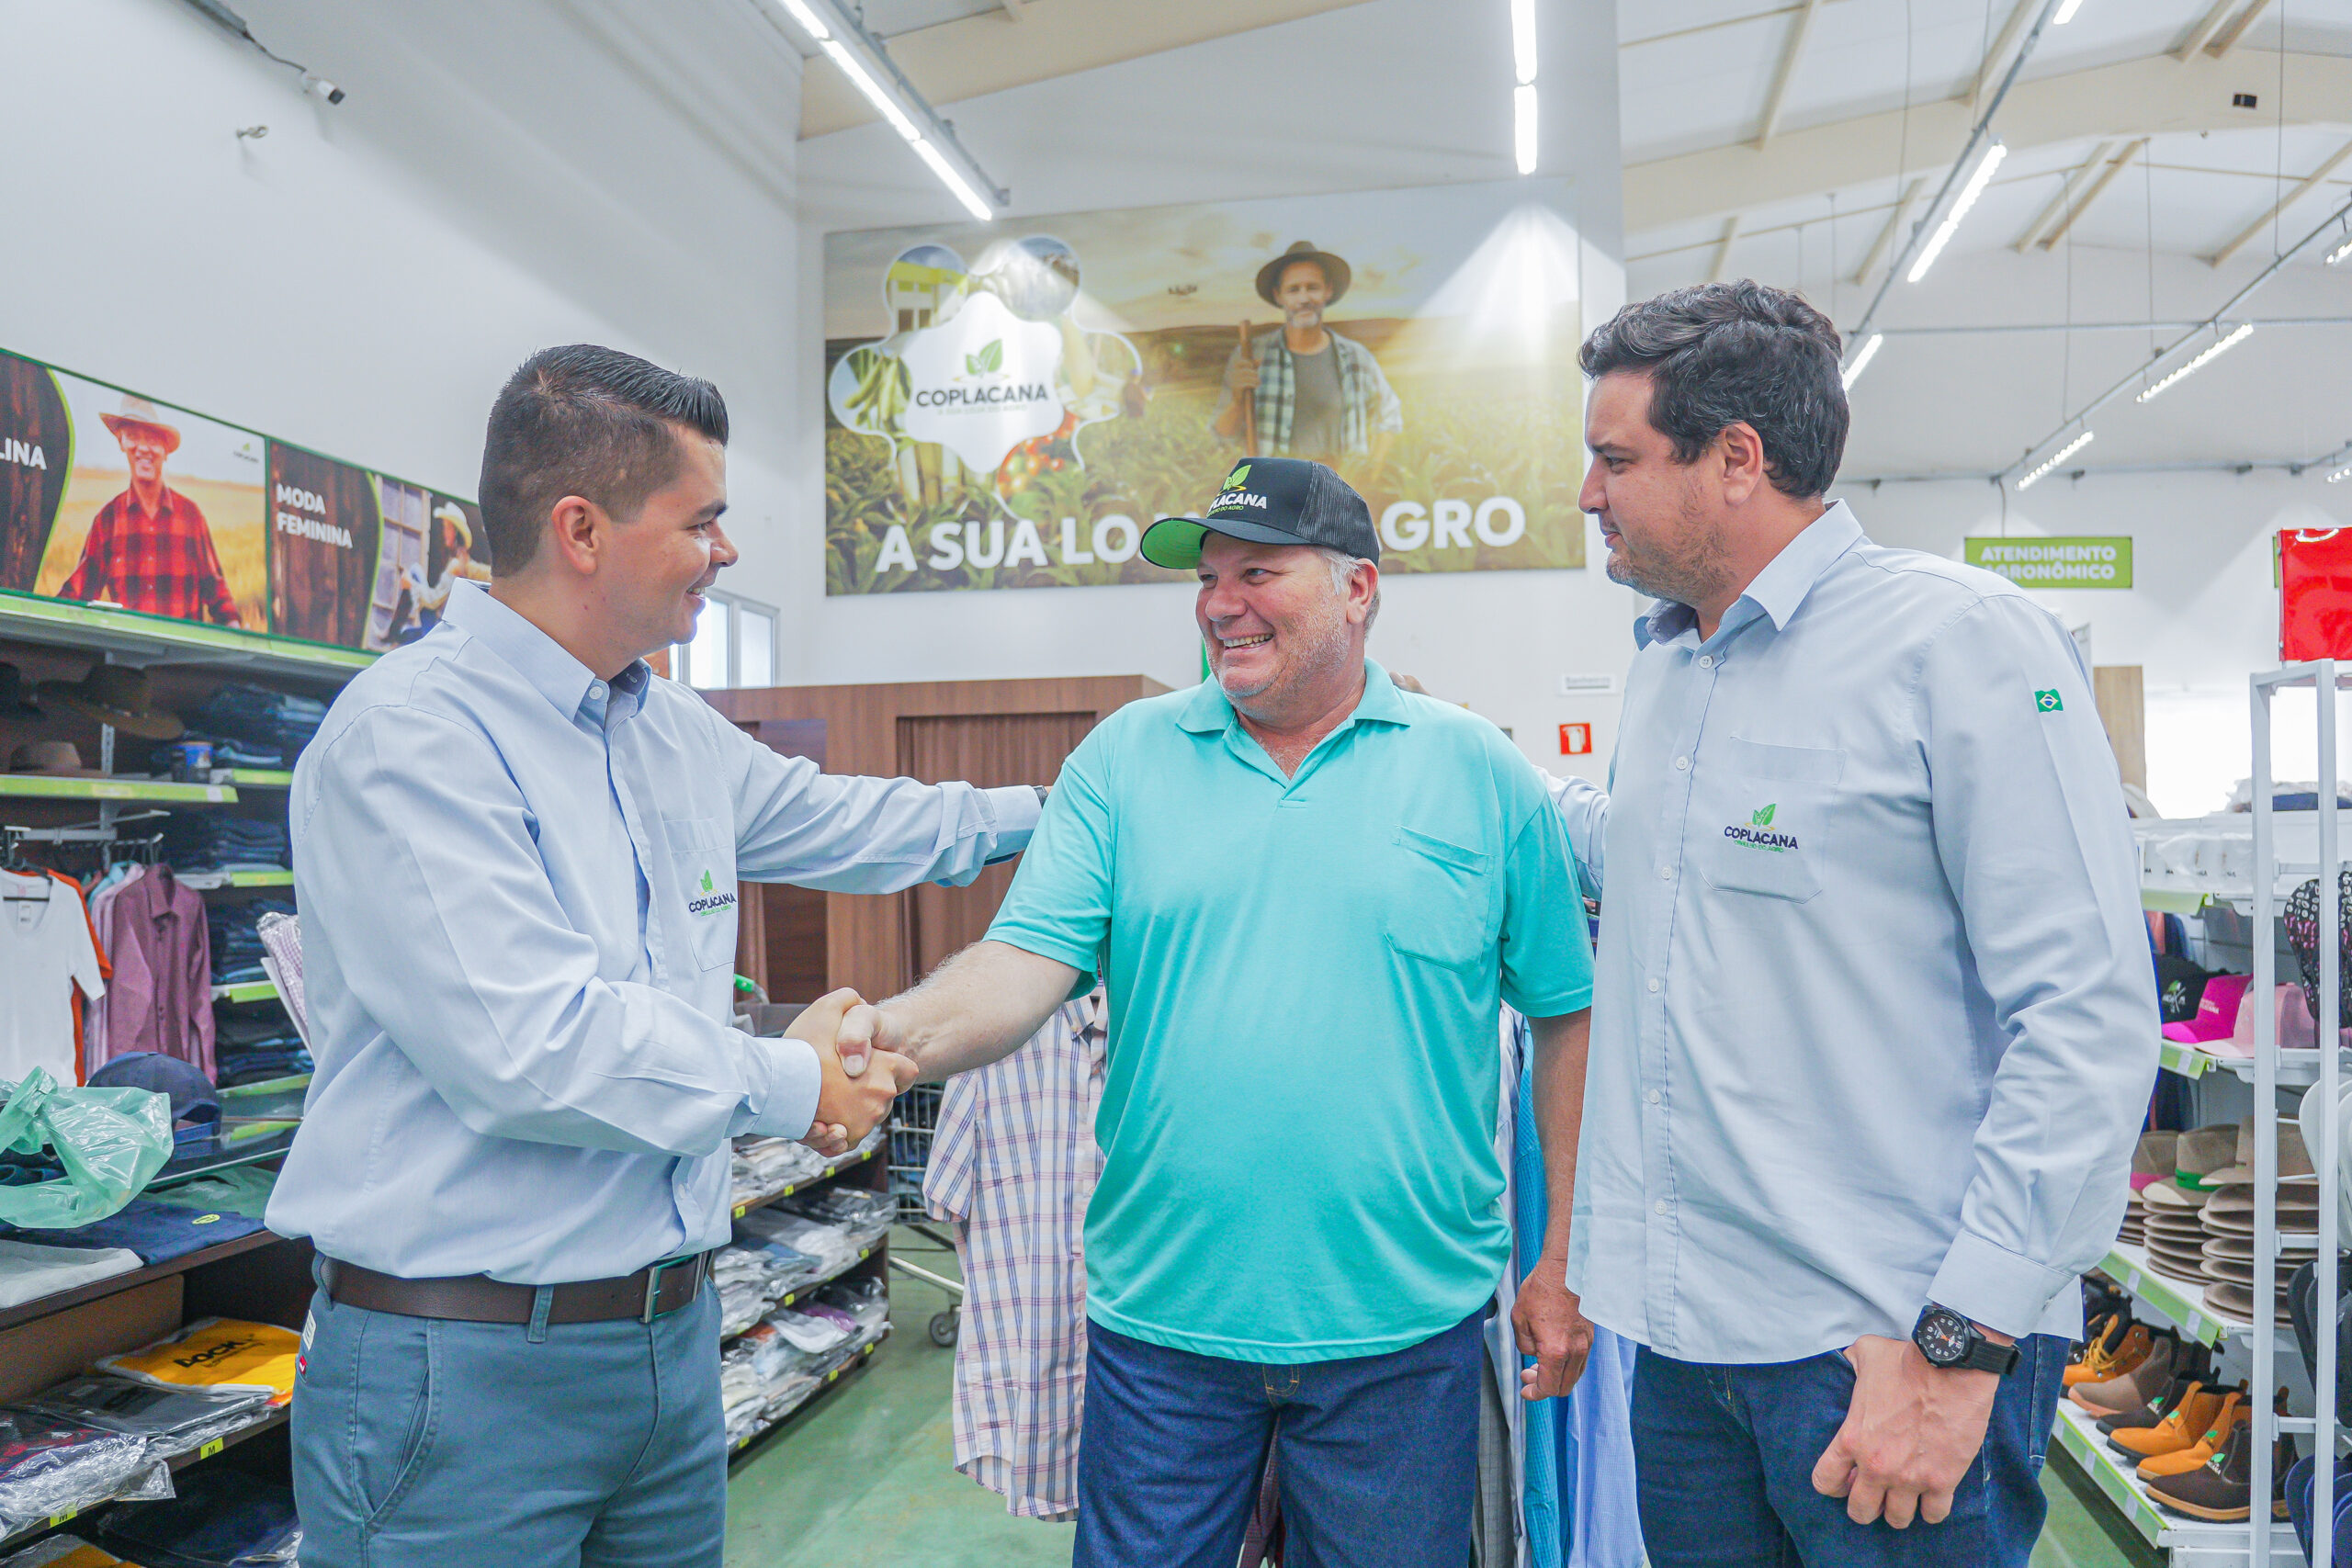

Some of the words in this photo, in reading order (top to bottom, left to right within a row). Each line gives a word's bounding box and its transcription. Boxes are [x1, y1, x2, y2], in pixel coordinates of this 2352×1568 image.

[916, 383, 1048, 407] COPLACANA
[277, 482, 326, 515] MODA
[277, 511, 353, 549] FEMININA
[875, 524, 918, 572] A
[928, 518, 1048, 571] SUA
[1379, 495, 1526, 551] GRO
[1981, 546, 2117, 561] ATENDIMENTO
[1724, 825, 1798, 850] COPLACANA
[688, 892, 737, 913] COPLACANA
[208, 1445, 216, 1456] M
